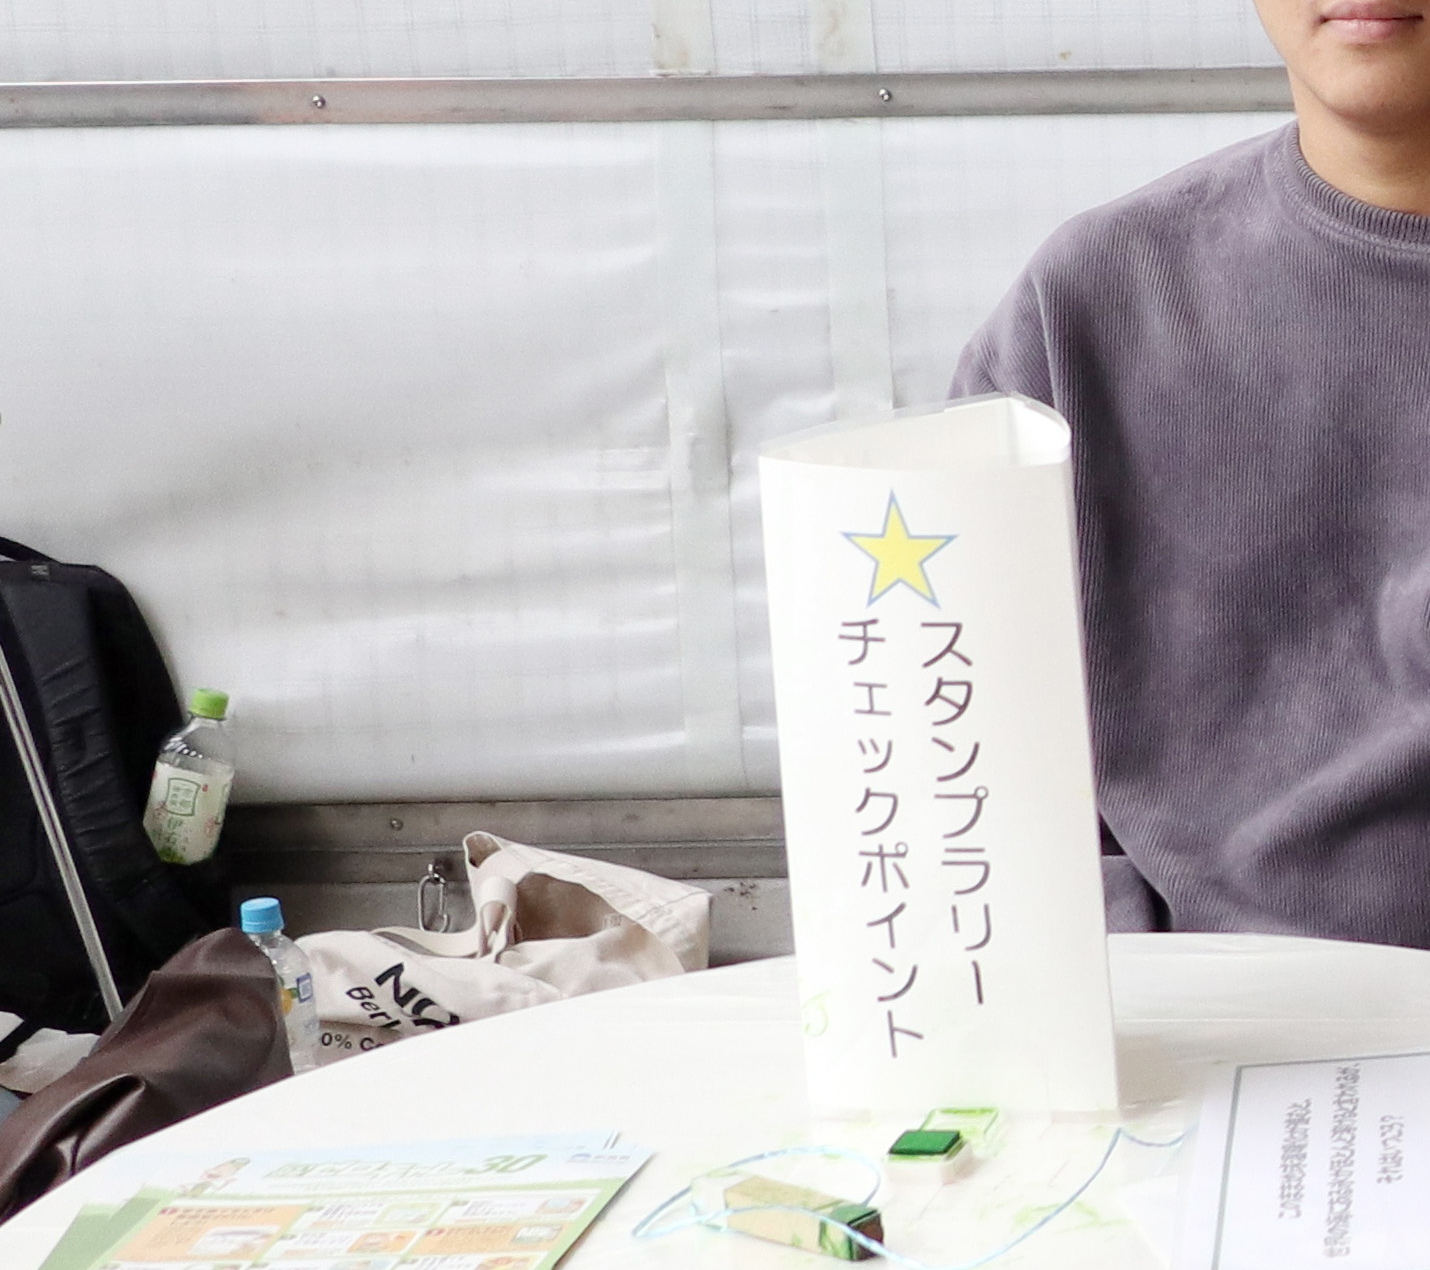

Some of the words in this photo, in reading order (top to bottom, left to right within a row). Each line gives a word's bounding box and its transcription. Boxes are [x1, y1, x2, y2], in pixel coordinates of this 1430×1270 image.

[838, 618, 924, 1060] チェックポイント
[920, 620, 995, 1006] スタンプラリー
